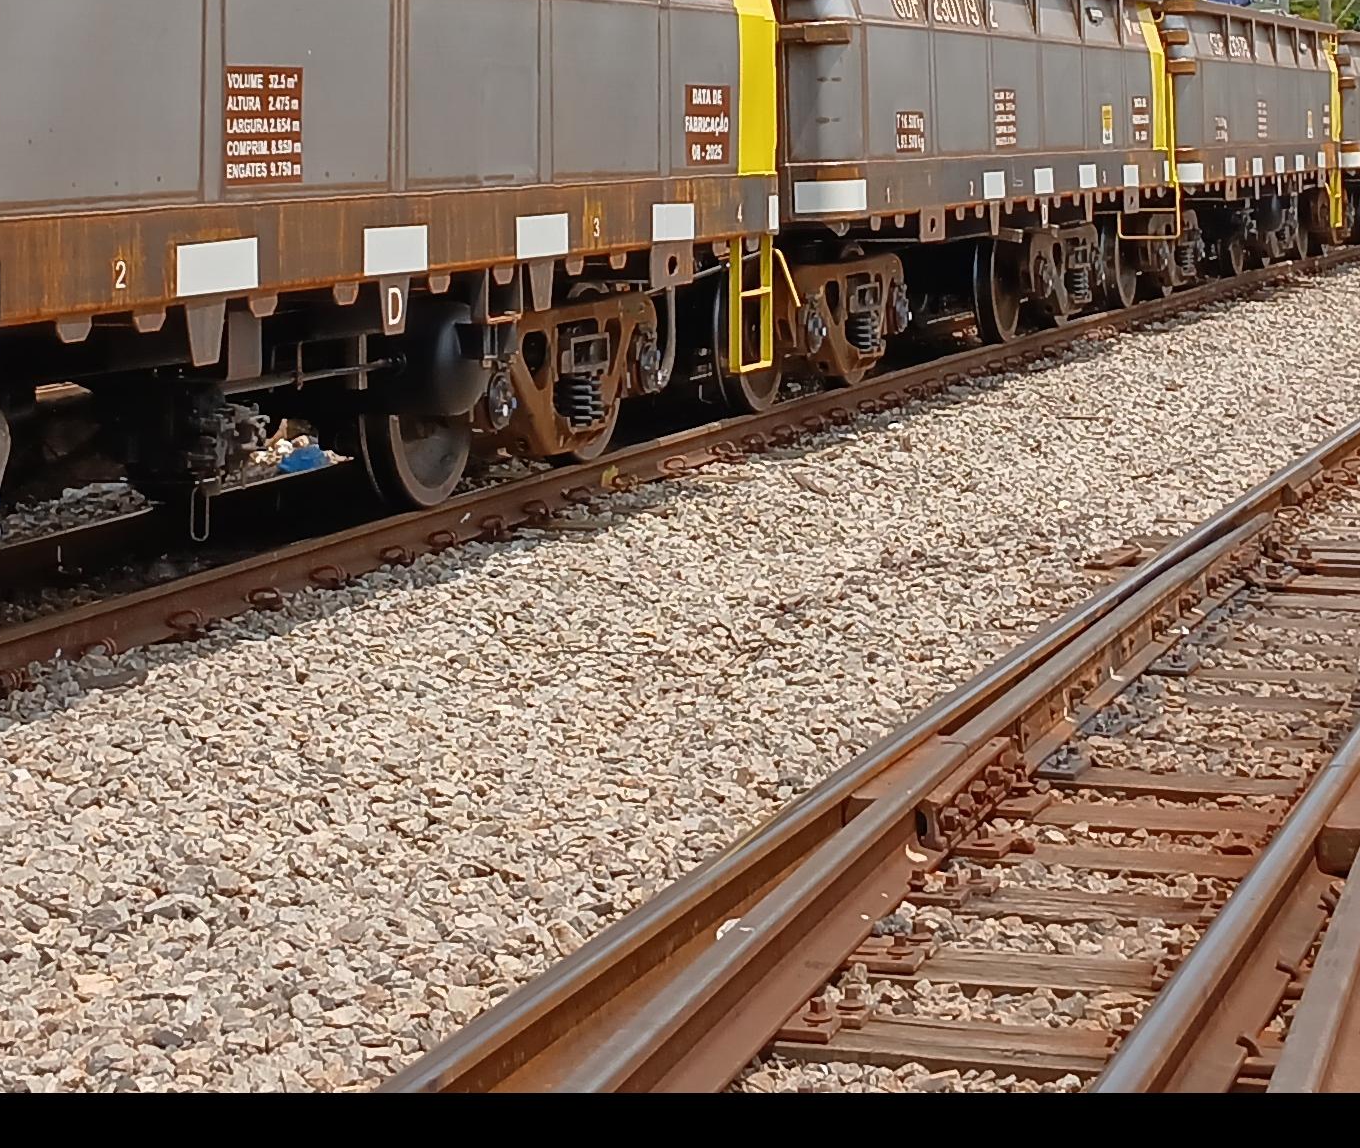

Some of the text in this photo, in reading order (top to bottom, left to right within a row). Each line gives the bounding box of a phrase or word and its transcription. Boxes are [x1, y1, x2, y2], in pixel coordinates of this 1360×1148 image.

[227, 73, 263, 89] VOLUME
[226, 96, 298, 111] ALTURA 2.475 m
[692, 88, 722, 105] DATA DE
[226, 118, 268, 133] LARGURA
[292, 120, 300, 131] m
[293, 142, 301, 153] m
[226, 162, 267, 178] ENGATES
[293, 164, 301, 175] m
[737, 203, 743, 223] 4
[593, 217, 600, 237] 3
[115, 260, 127, 289] 2
[388, 287, 403, 325] D
